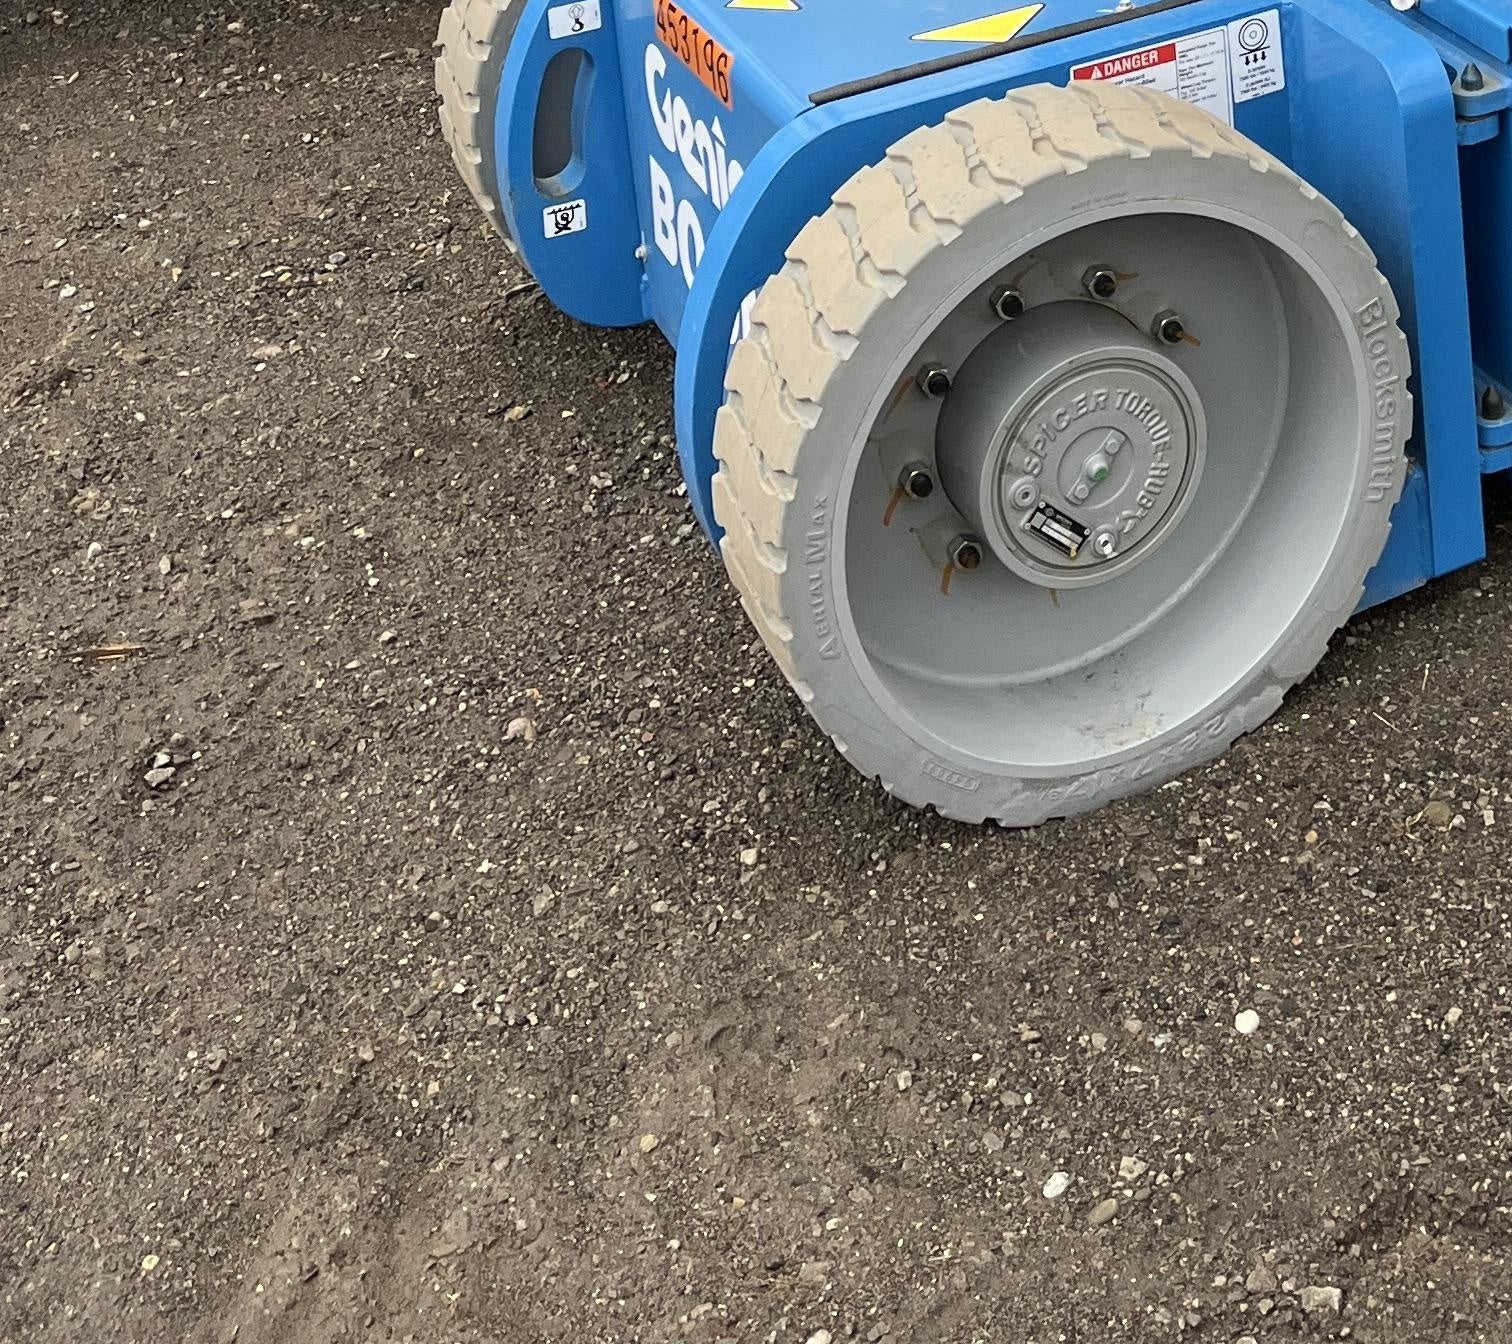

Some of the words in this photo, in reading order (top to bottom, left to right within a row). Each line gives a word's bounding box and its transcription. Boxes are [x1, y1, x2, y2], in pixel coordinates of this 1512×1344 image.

[1103, 49, 1159, 77] DANGER
[1023, 388, 1110, 479] SPICER
[1114, 388, 1172, 510] TORQUE-HUB
[1355, 296, 1400, 504] Blacksmith
